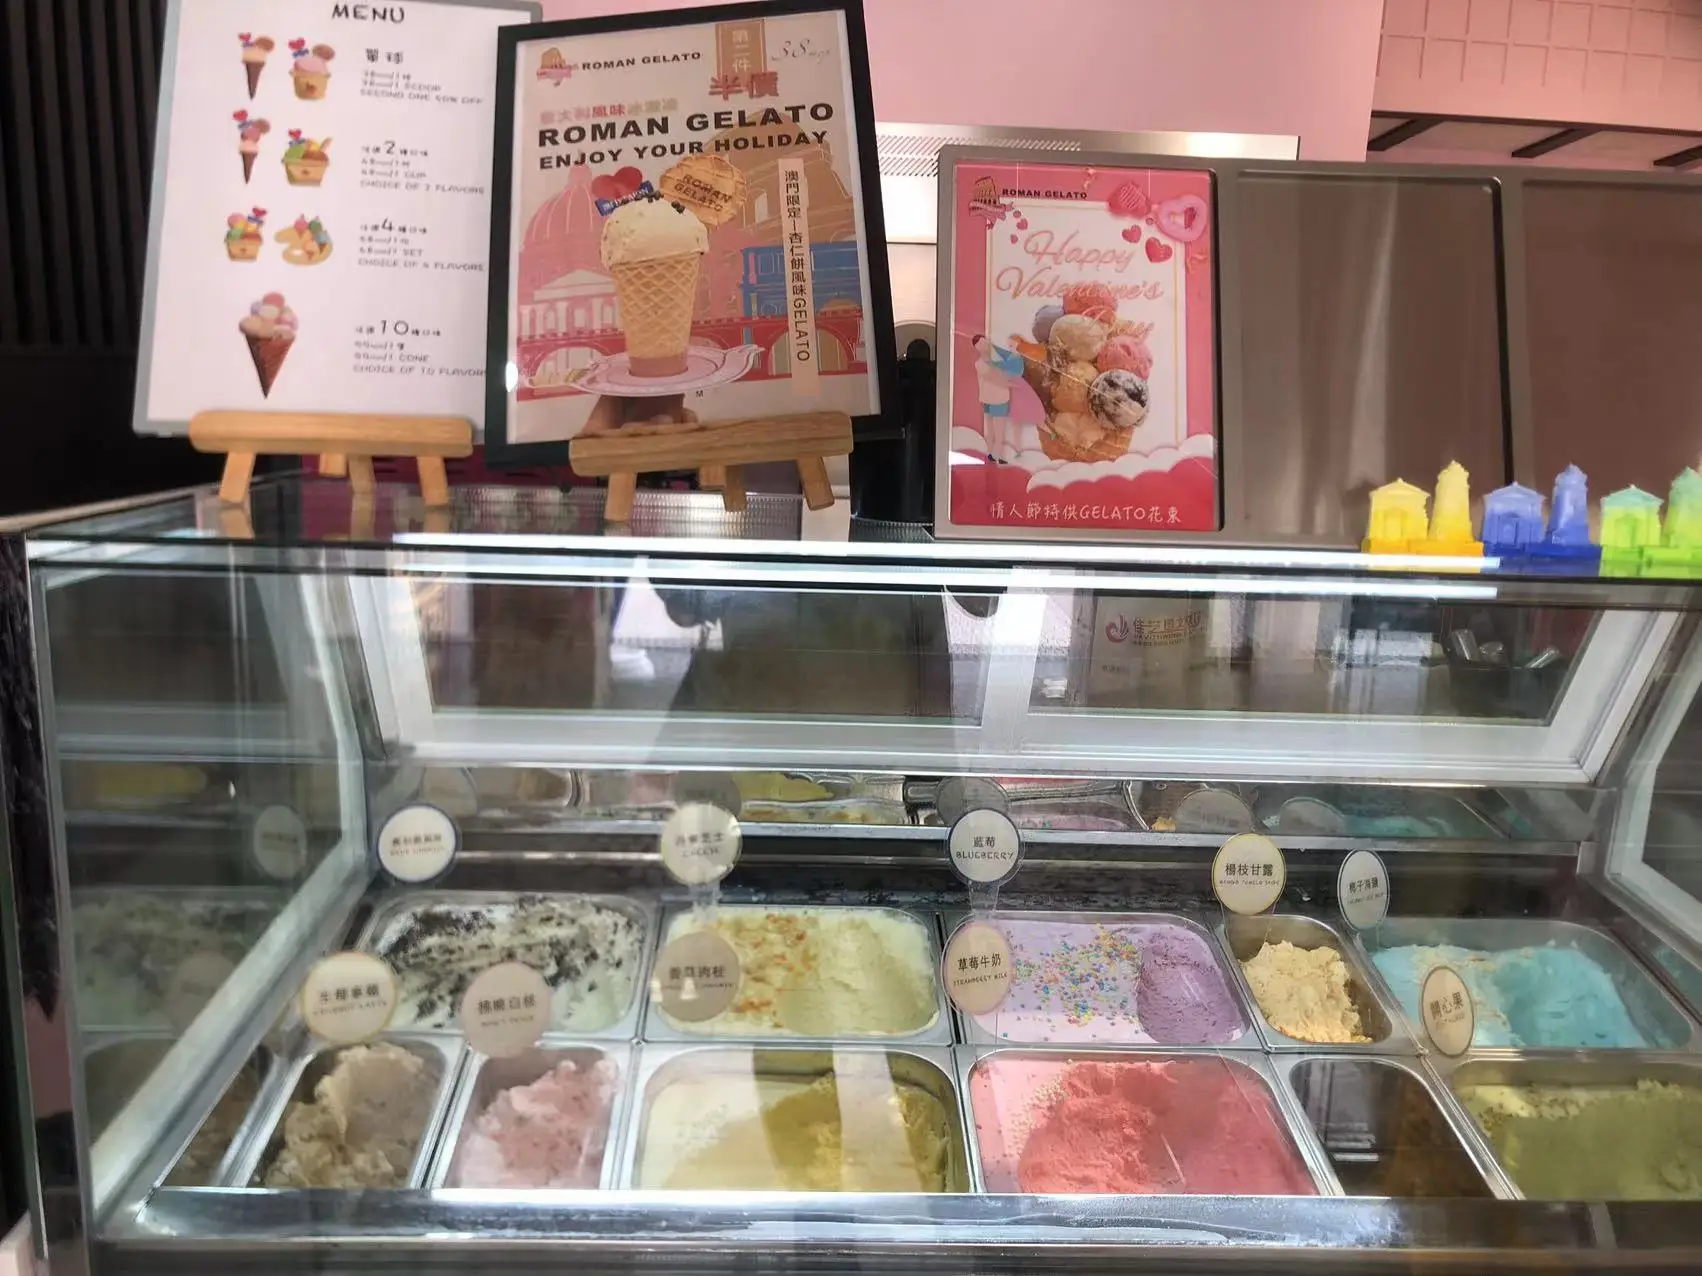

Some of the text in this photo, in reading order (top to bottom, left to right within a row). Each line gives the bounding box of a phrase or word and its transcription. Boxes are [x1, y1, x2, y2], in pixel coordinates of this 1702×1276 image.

[331, 4, 405, 24] MENU
[581, 52, 701, 71] ROMAN GELATO
[708, 70, 780, 101] 半價
[538, 102, 834, 147] ROMAN GELATO
[539, 129, 829, 170] ENJOY YOUR HOLIDAY
[683, 173, 733, 204] ROMAN
[1001, 188, 1088, 200] ROMAN GELATO
[1023, 229, 1136, 272] Happy
[955, 851, 1014, 861] BLUEBERRY
[1225, 863, 1274, 877] 楊枝甘露
[957, 952, 1002, 972] 草莓牛奶
